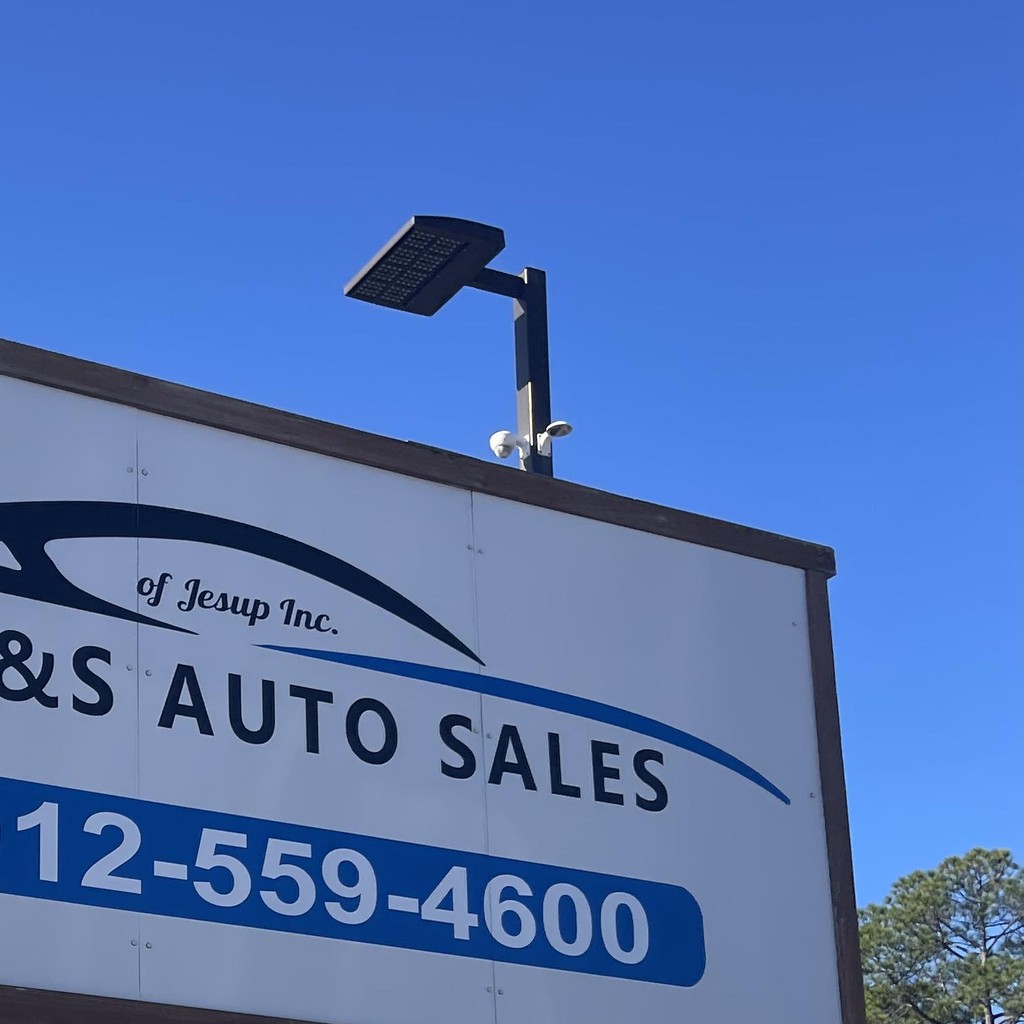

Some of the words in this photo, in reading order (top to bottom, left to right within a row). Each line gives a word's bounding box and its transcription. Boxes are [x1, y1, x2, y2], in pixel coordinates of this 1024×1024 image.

[136, 572, 173, 607] of
[177, 578, 270, 627] Jesup
[279, 598, 339, 636] Inc.
[157, 663, 399, 766] AUTO
[438, 713, 669, 813] SALES
